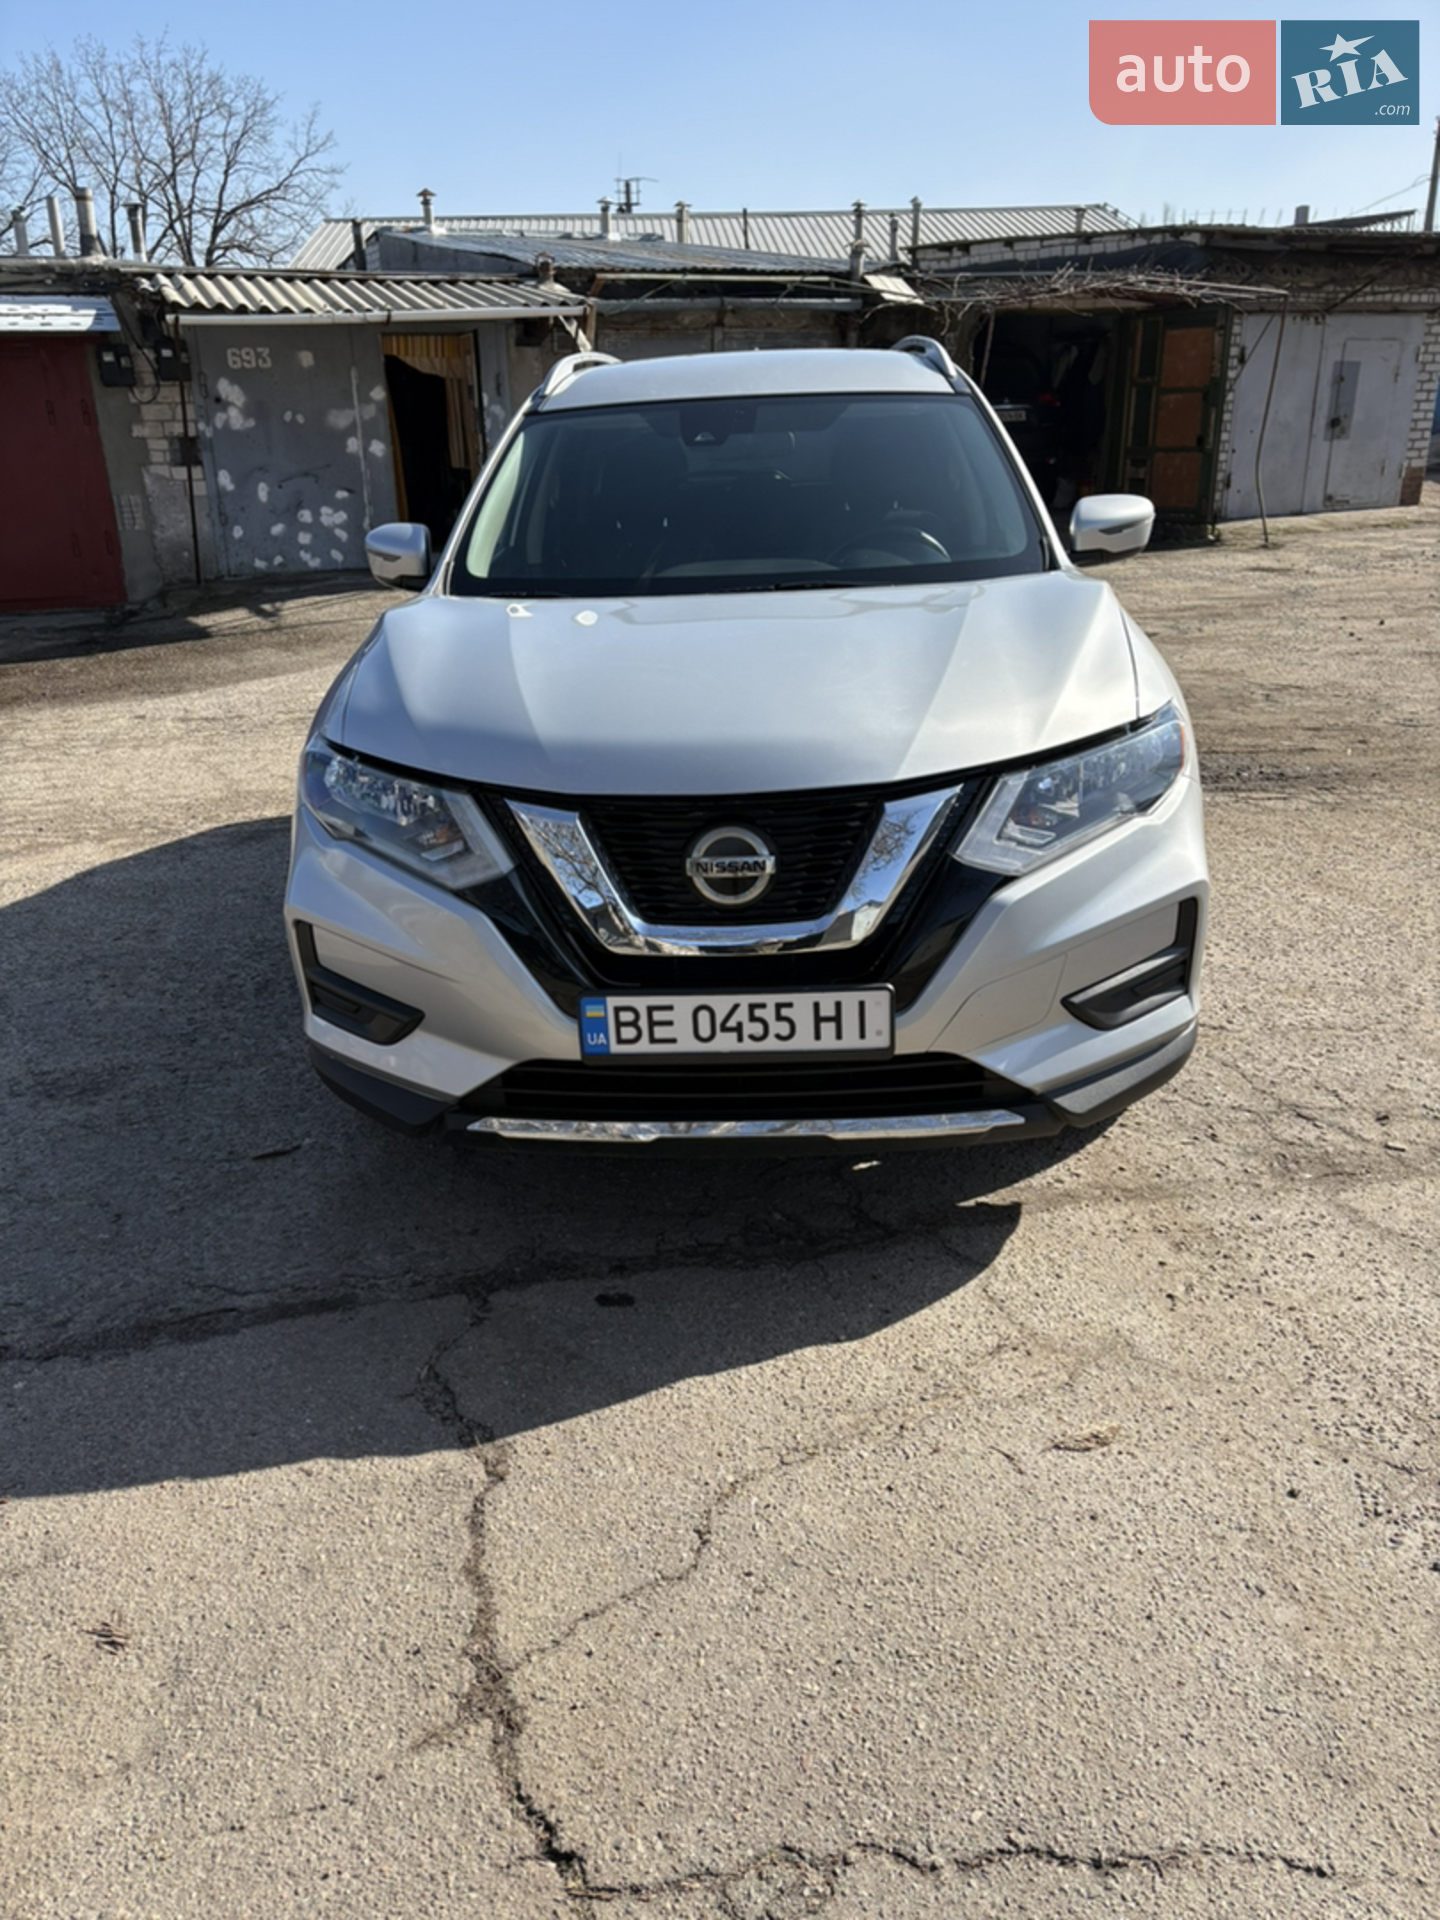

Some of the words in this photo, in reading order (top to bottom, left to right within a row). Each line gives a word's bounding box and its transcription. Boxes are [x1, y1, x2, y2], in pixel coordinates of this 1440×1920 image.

[227, 347, 272, 369] 693
[696, 860, 766, 873] NISSAN
[613, 1005, 677, 1045] BE
[692, 1002, 796, 1043] 0455
[813, 1000, 866, 1041] HI
[587, 1032, 607, 1045] UA
